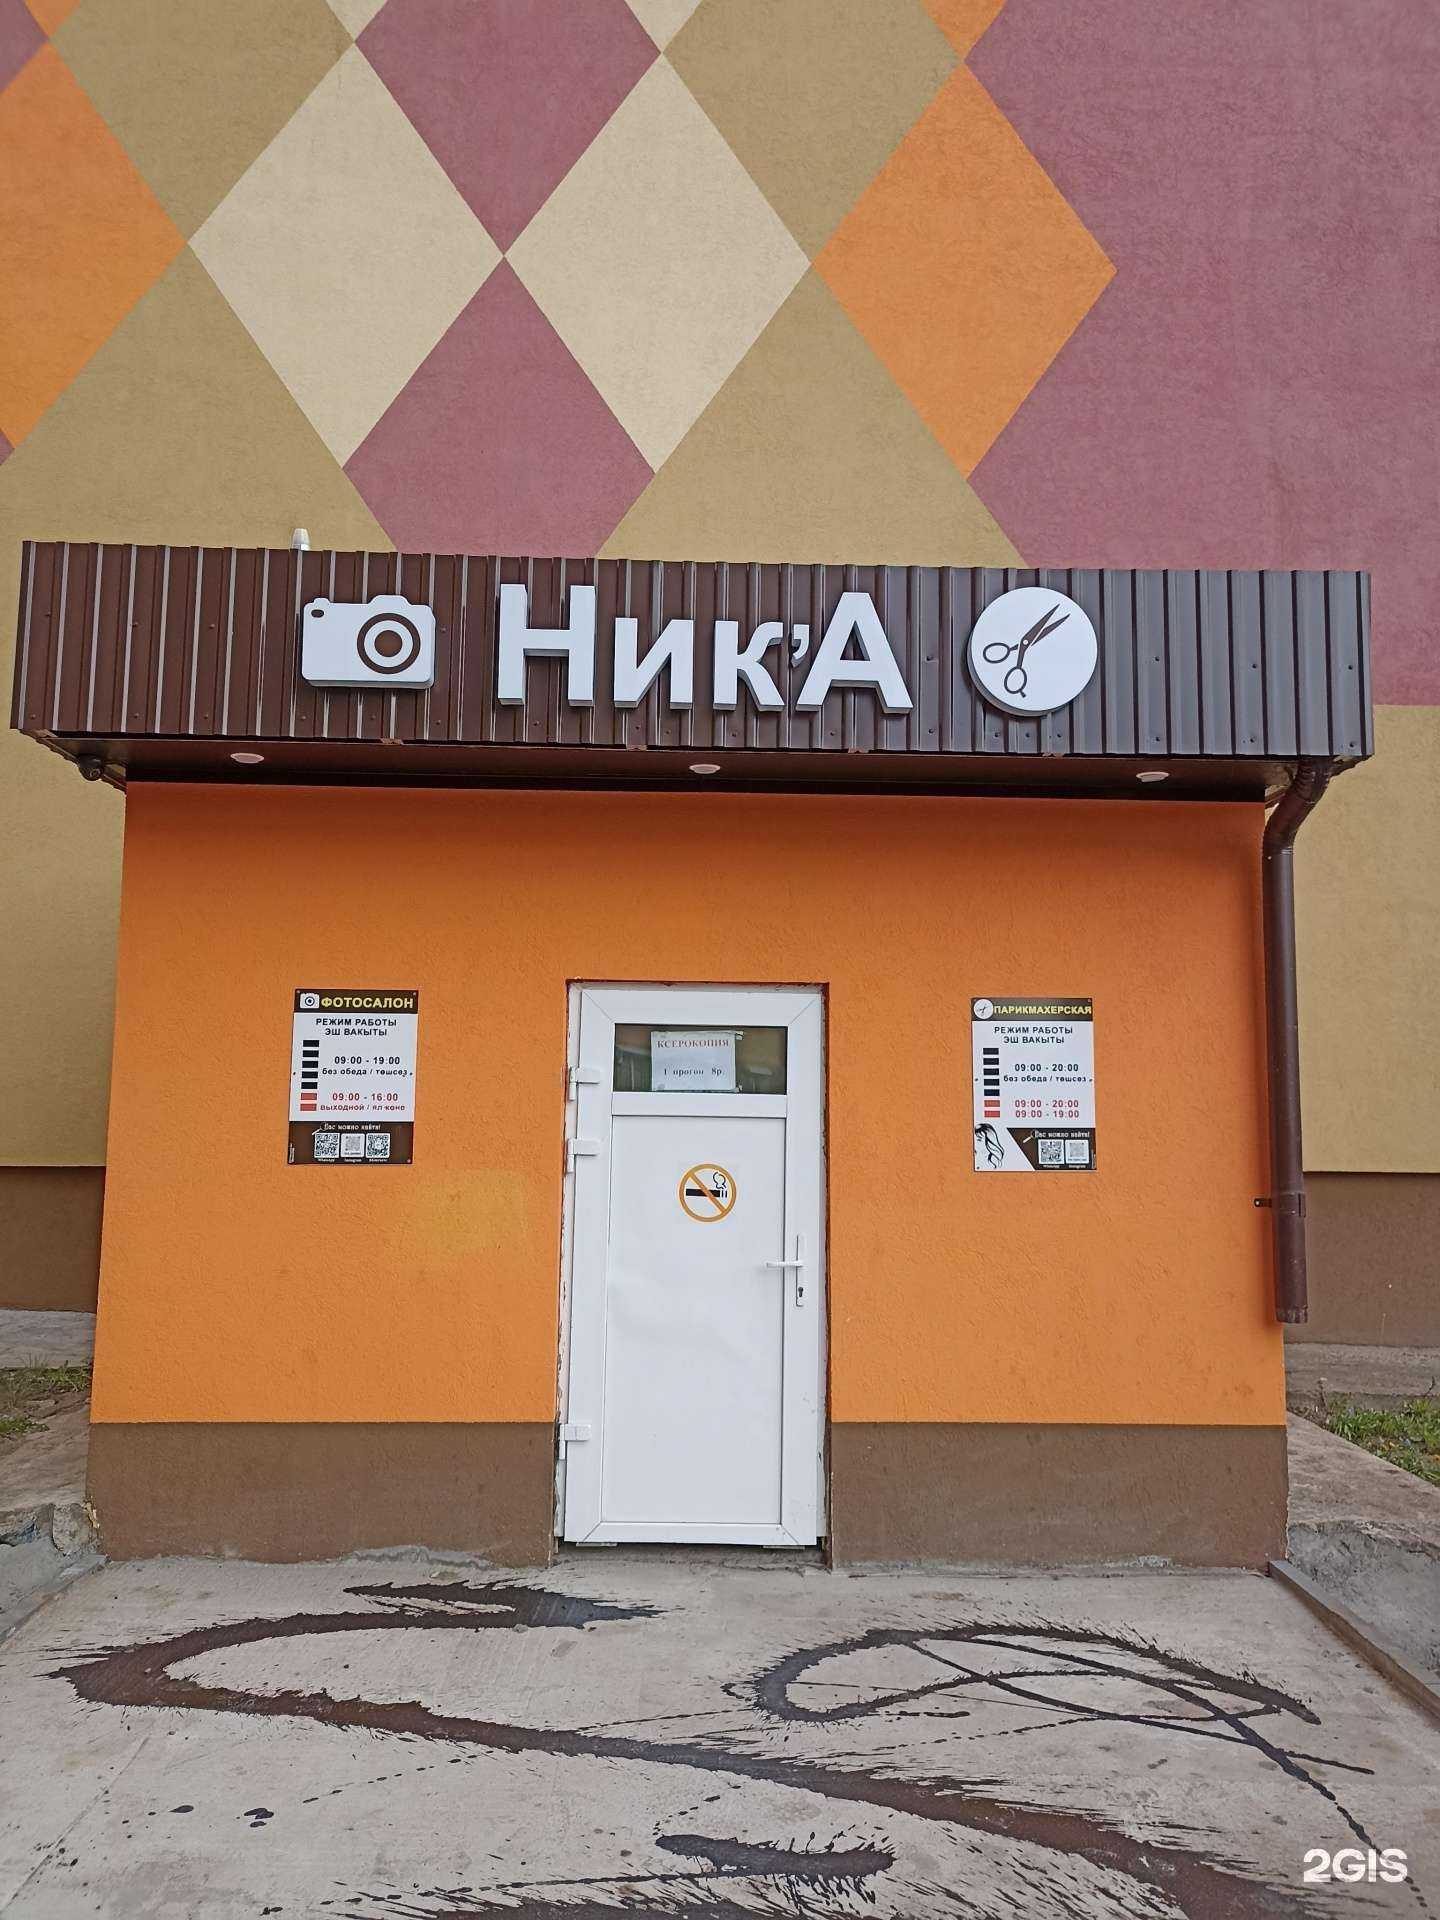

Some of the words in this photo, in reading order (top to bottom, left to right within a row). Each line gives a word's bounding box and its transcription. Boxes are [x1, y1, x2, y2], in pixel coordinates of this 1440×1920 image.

[321, 997, 414, 1009] ФОТОСАЛОН
[993, 1005, 1092, 1015] ПАРИКМАХЕРСКАЯ
[315, 1018, 352, 1026] РЕЖИМ
[355, 1019, 397, 1027] РАБОТЫ
[325, 1028, 341, 1036] ЭШ
[343, 1028, 388, 1036] ВАКЫТЫ
[994, 1026, 1029, 1034] РЕЖИМ
[1032, 1026, 1073, 1034] РАБОТЫ
[657, 1039, 729, 1049] КСЕРОКОПИЯ
[1003, 1036, 1019, 1044] ЭШ
[1022, 1036, 1065, 1044] ВАКЫТЫ
[334, 1056, 362, 1065] 09:00
[373, 1056, 400, 1065] 19:00
[340, 1068, 367, 1076] обеда
[1014, 1064, 1042, 1072] 09:00
[1051, 1064, 1079, 1072] 20:00
[1021, 1075, 1047, 1083] обеда
[332, 1093, 360, 1101] 09:00
[371, 1093, 398, 1101] 16:00
[1015, 1100, 1042, 1108] 09:00
[1052, 1100, 1079, 1108] 20:00
[1015, 1110, 1042, 1118] 09:00
[1054, 1110, 1080, 1118] 19:00
